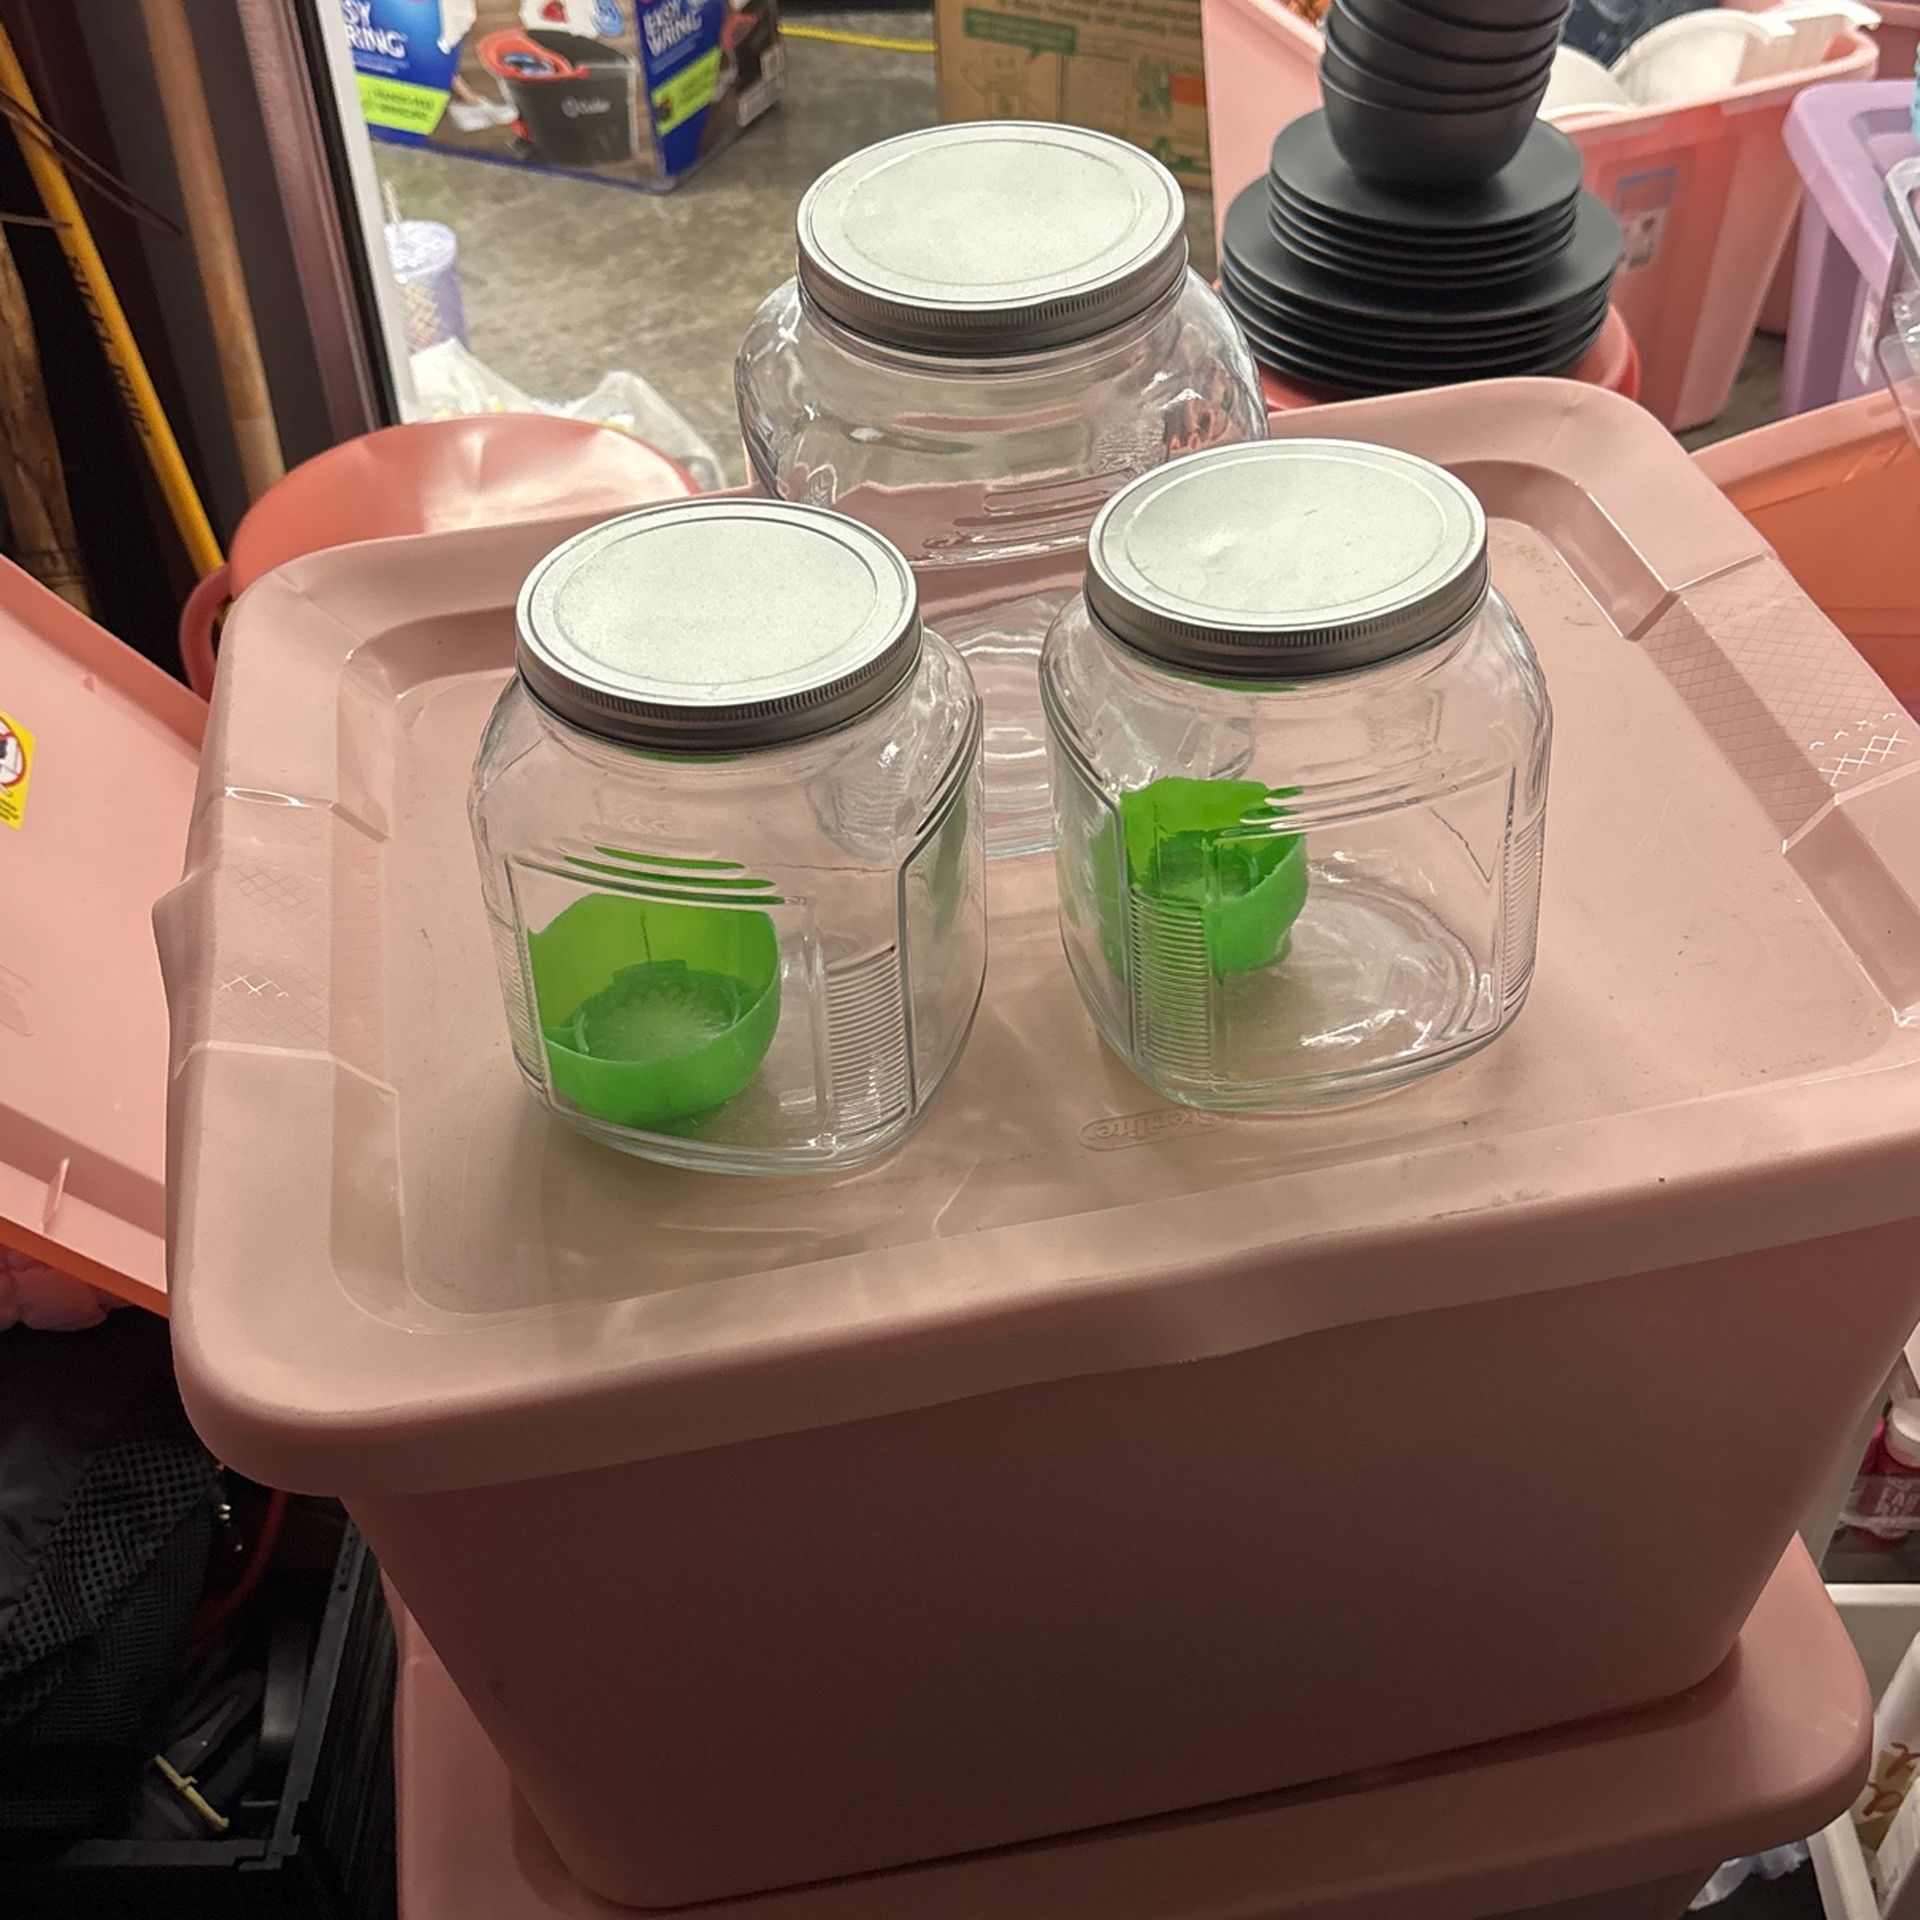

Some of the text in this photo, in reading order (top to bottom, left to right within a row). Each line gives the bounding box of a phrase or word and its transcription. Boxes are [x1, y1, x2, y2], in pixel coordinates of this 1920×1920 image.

[342, 0, 371, 29] SY
[346, 24, 406, 59] RING
[646, 10, 702, 57] WRING
